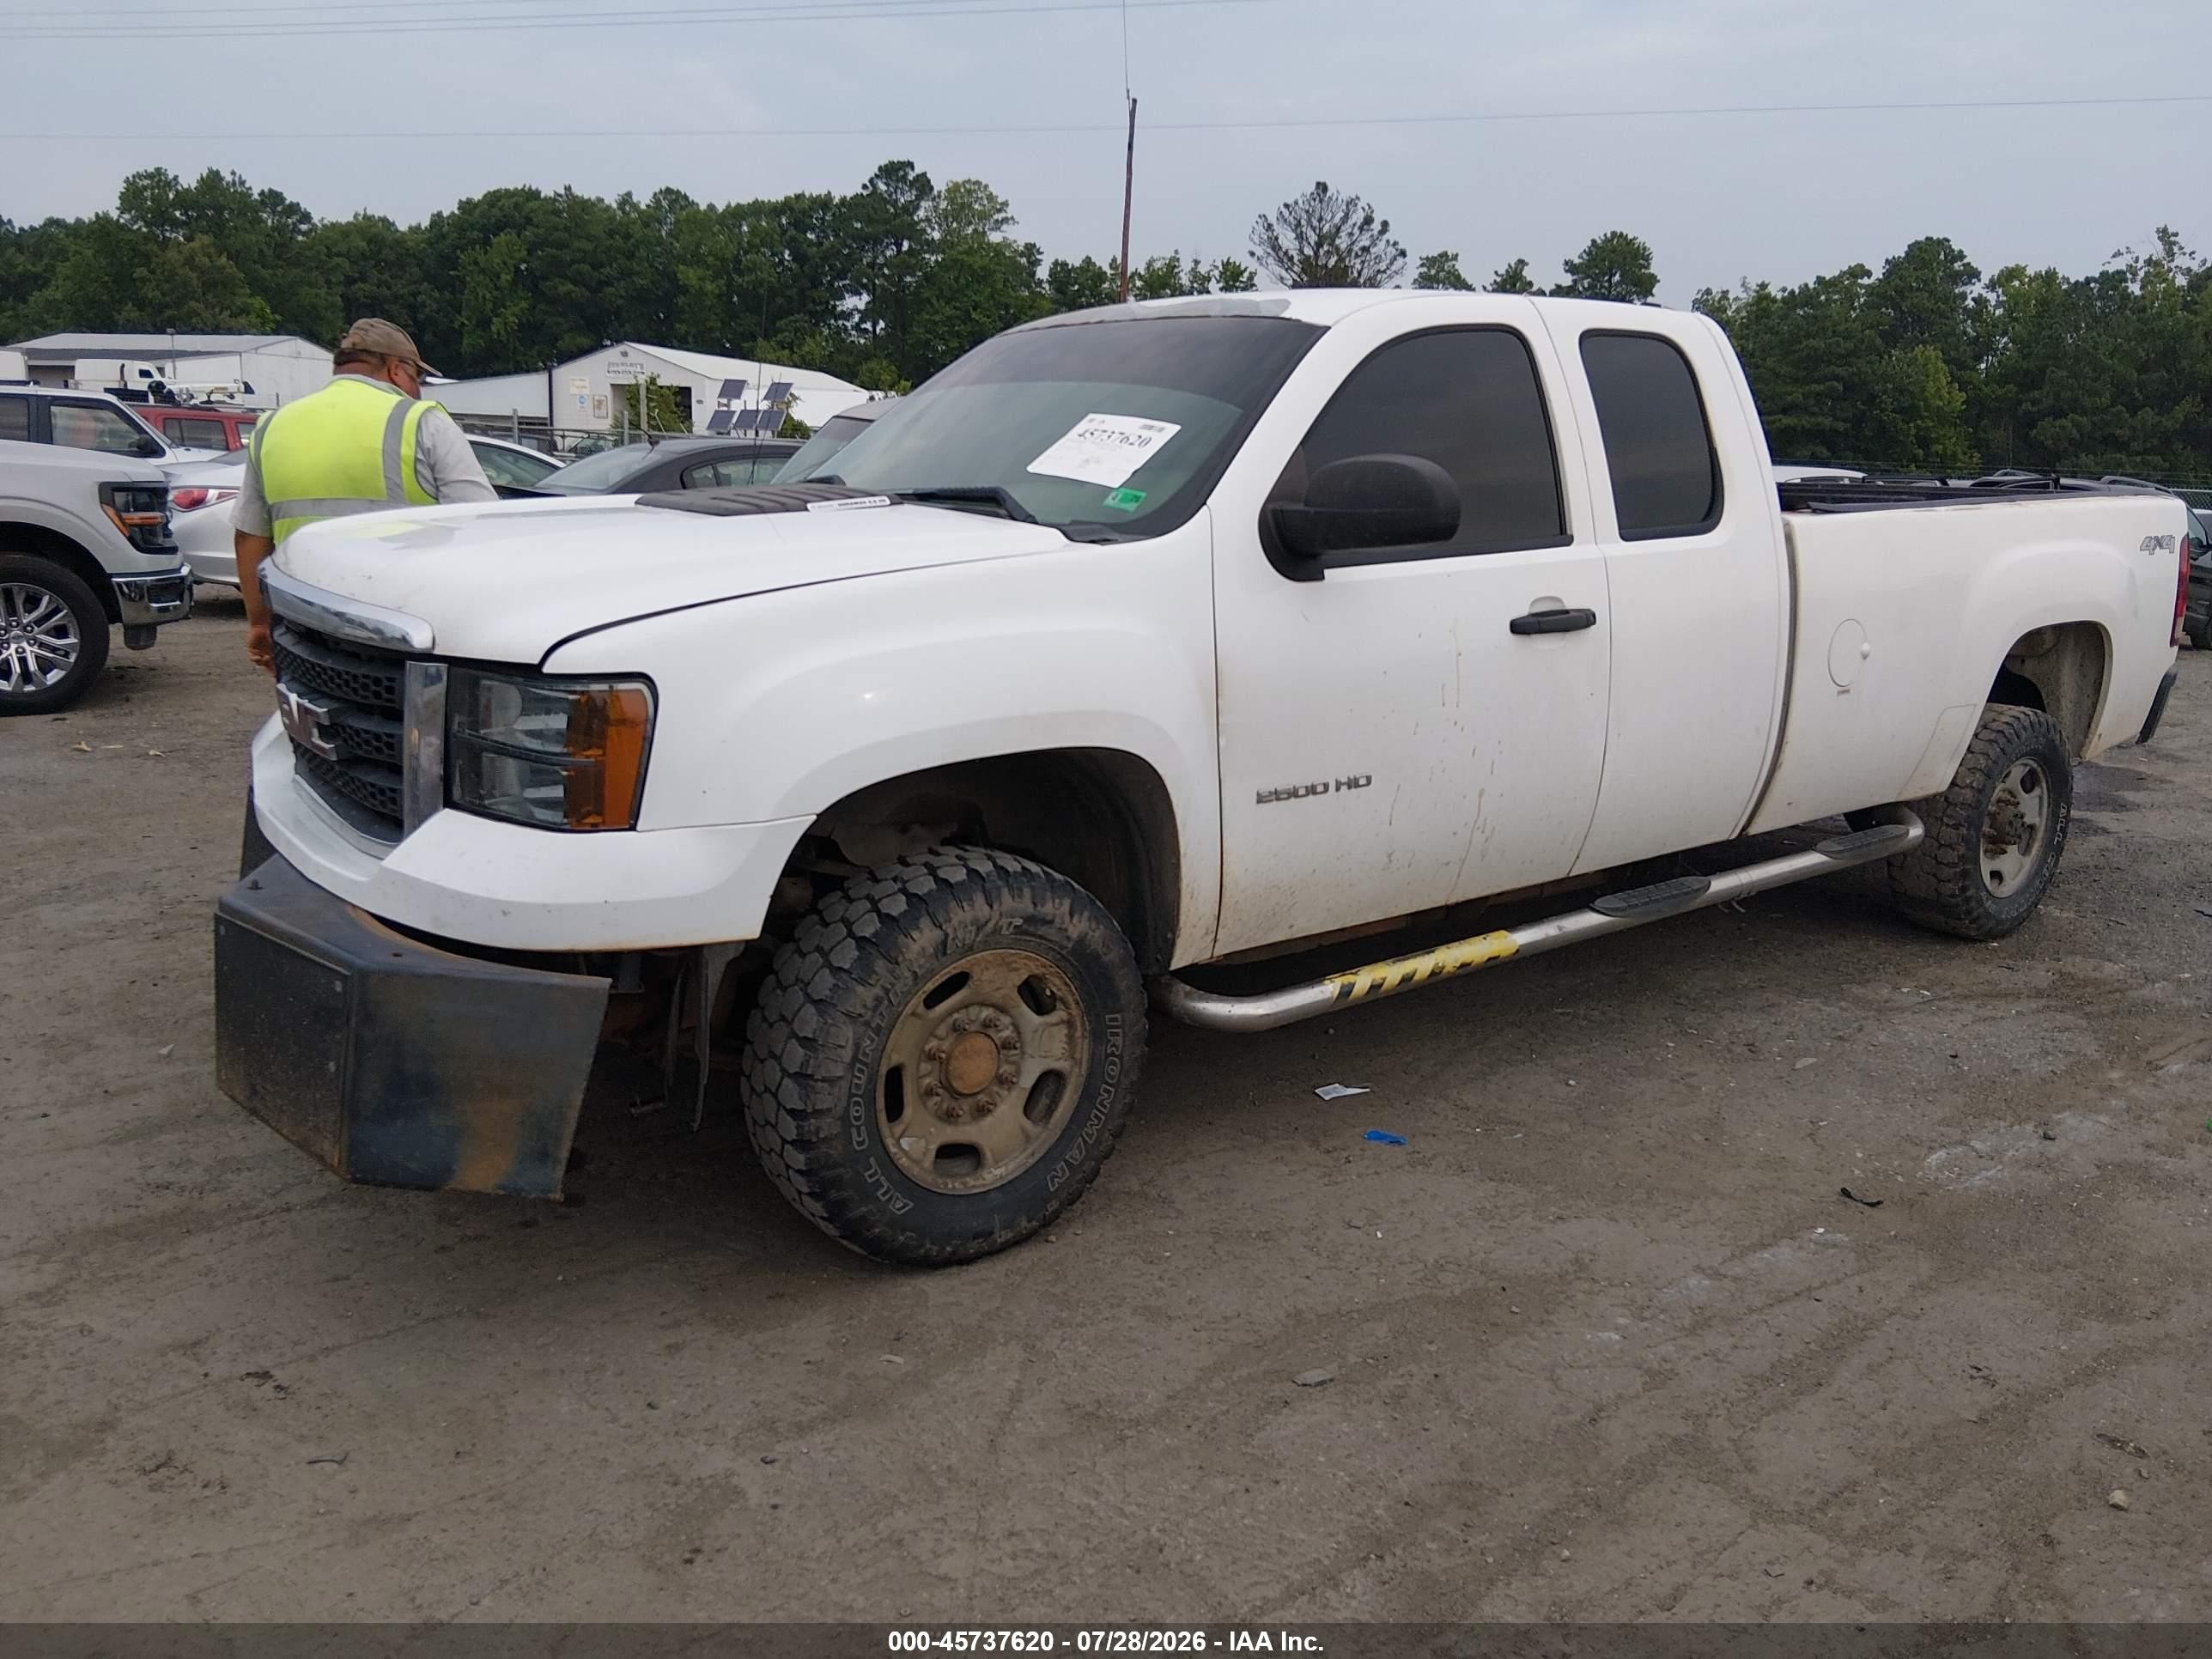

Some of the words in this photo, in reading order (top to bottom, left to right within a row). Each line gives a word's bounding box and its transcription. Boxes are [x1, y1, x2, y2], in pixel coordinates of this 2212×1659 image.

[1255, 781, 1330, 805] 2500
[1334, 775, 1372, 793] HD
[1047, 1013, 1122, 1192] IRONMAN
[863, 1156, 915, 1215] ALL
